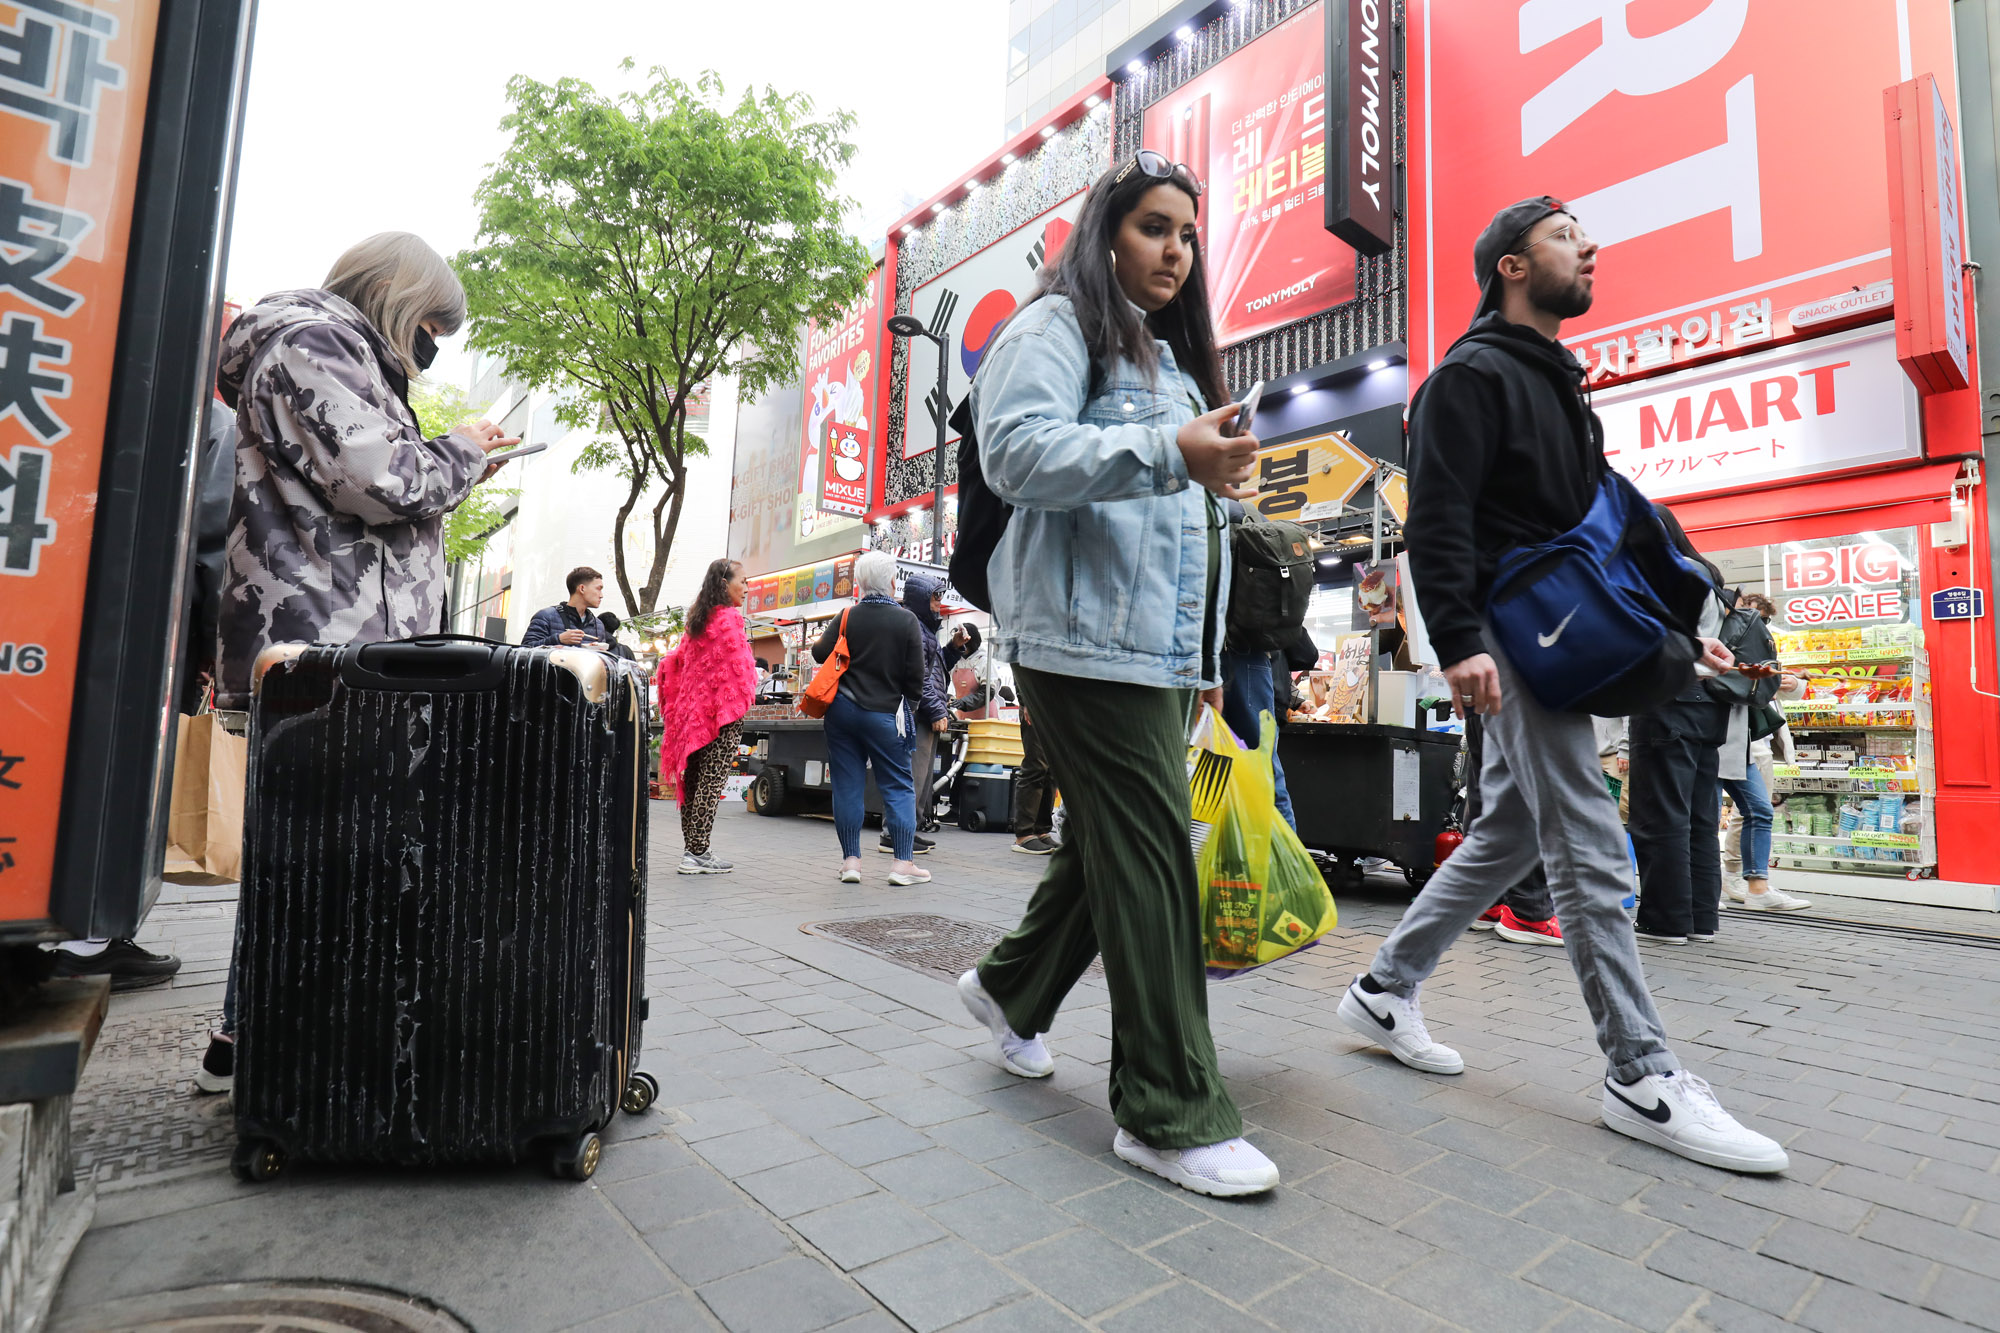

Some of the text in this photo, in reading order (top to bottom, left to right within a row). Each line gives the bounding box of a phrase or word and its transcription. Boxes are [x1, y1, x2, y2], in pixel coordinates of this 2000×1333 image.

[1361, 0, 1380, 211] ONYMOLY
[1231, 118, 1242, 136] 더
[1245, 274, 1320, 313] TONYMOLY
[1797, 289, 1887, 321] SNACK OUTLET
[808, 317, 865, 373] FAVORITES
[1639, 360, 1851, 450] MART
[1629, 437, 1786, 483] ソウルマート
[825, 480, 865, 500] MIXUE
[1231, 448, 1309, 516] 붕
[891, 529, 958, 562] K-BEU
[1793, 544, 1900, 589] BIG
[1947, 602, 1968, 615] 18
